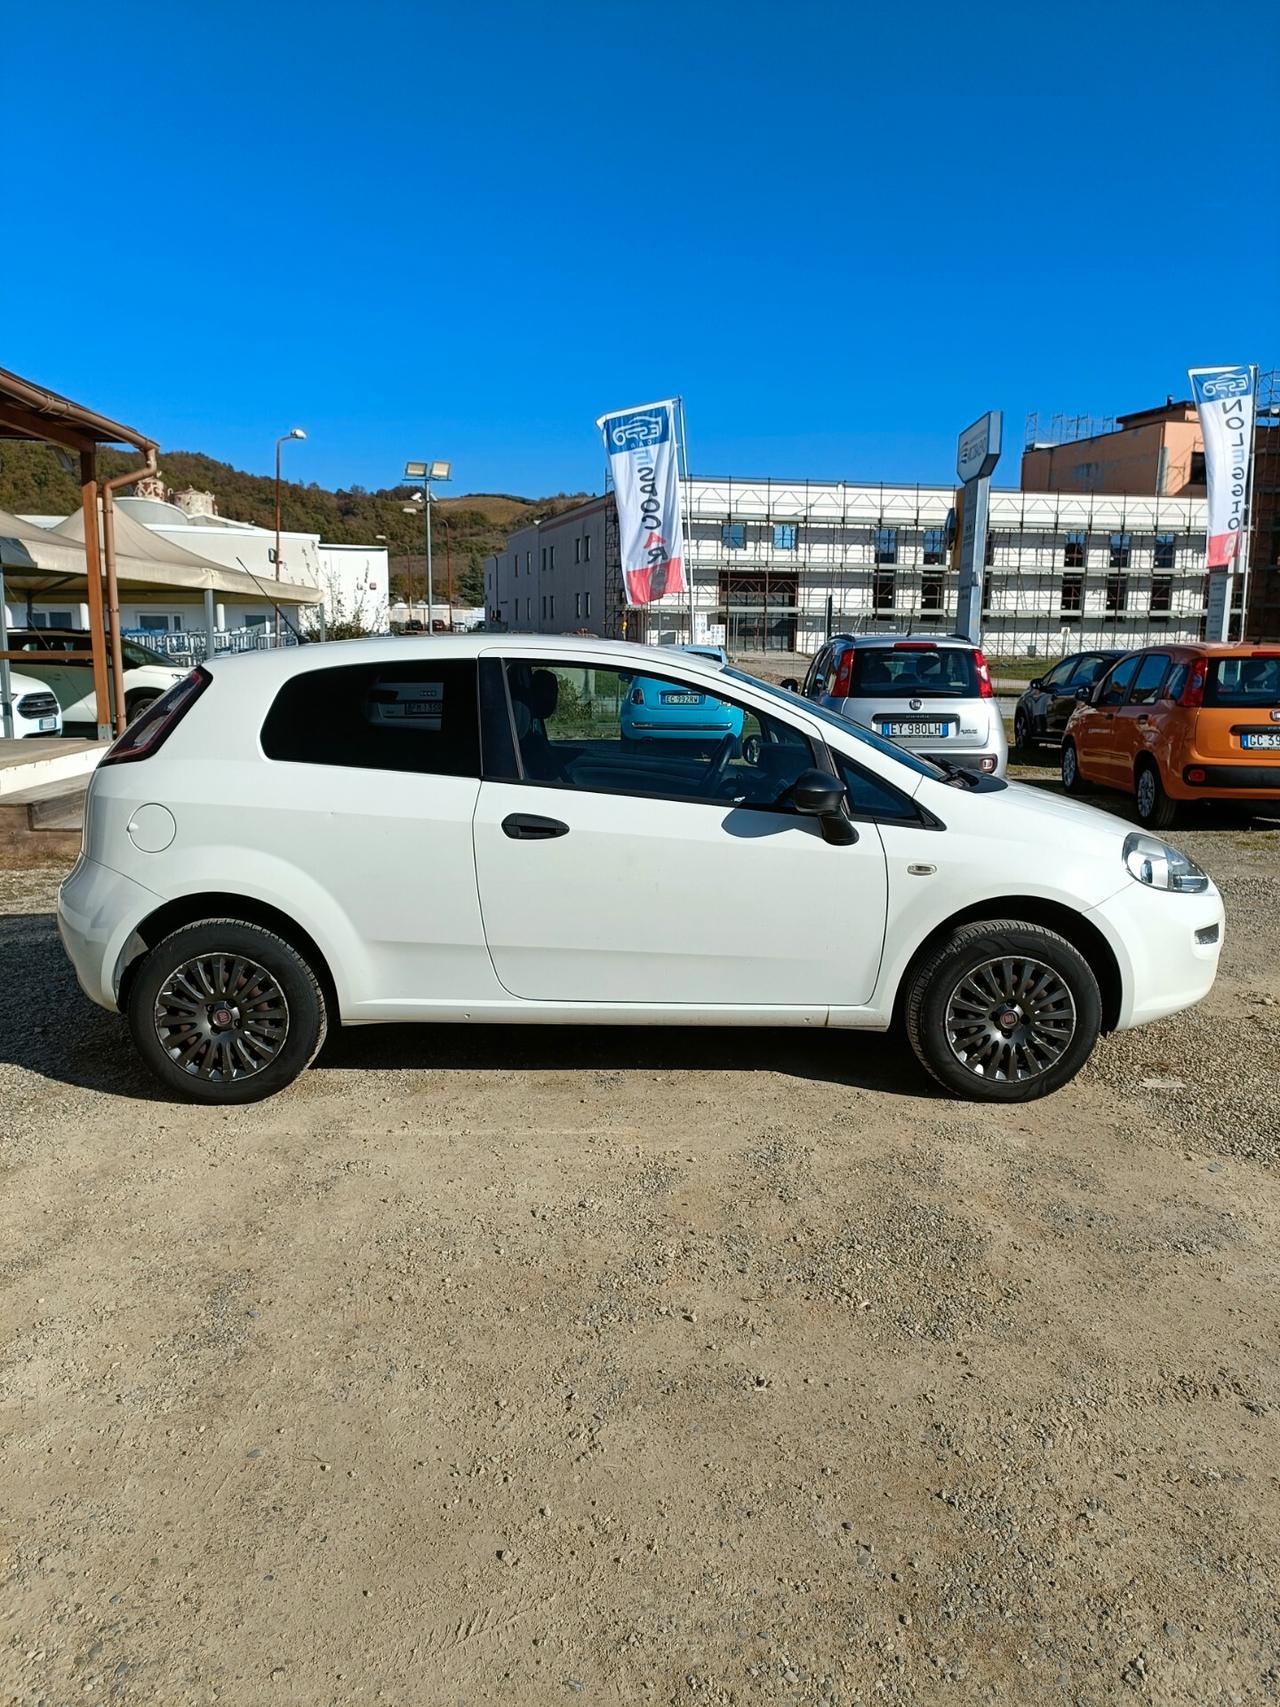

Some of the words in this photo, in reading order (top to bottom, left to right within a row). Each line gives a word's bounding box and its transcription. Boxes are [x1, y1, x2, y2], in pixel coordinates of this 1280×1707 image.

[891, 723, 904, 734] EY
[908, 723, 941, 734] 980LH
[1250, 734, 1263, 746] GC
